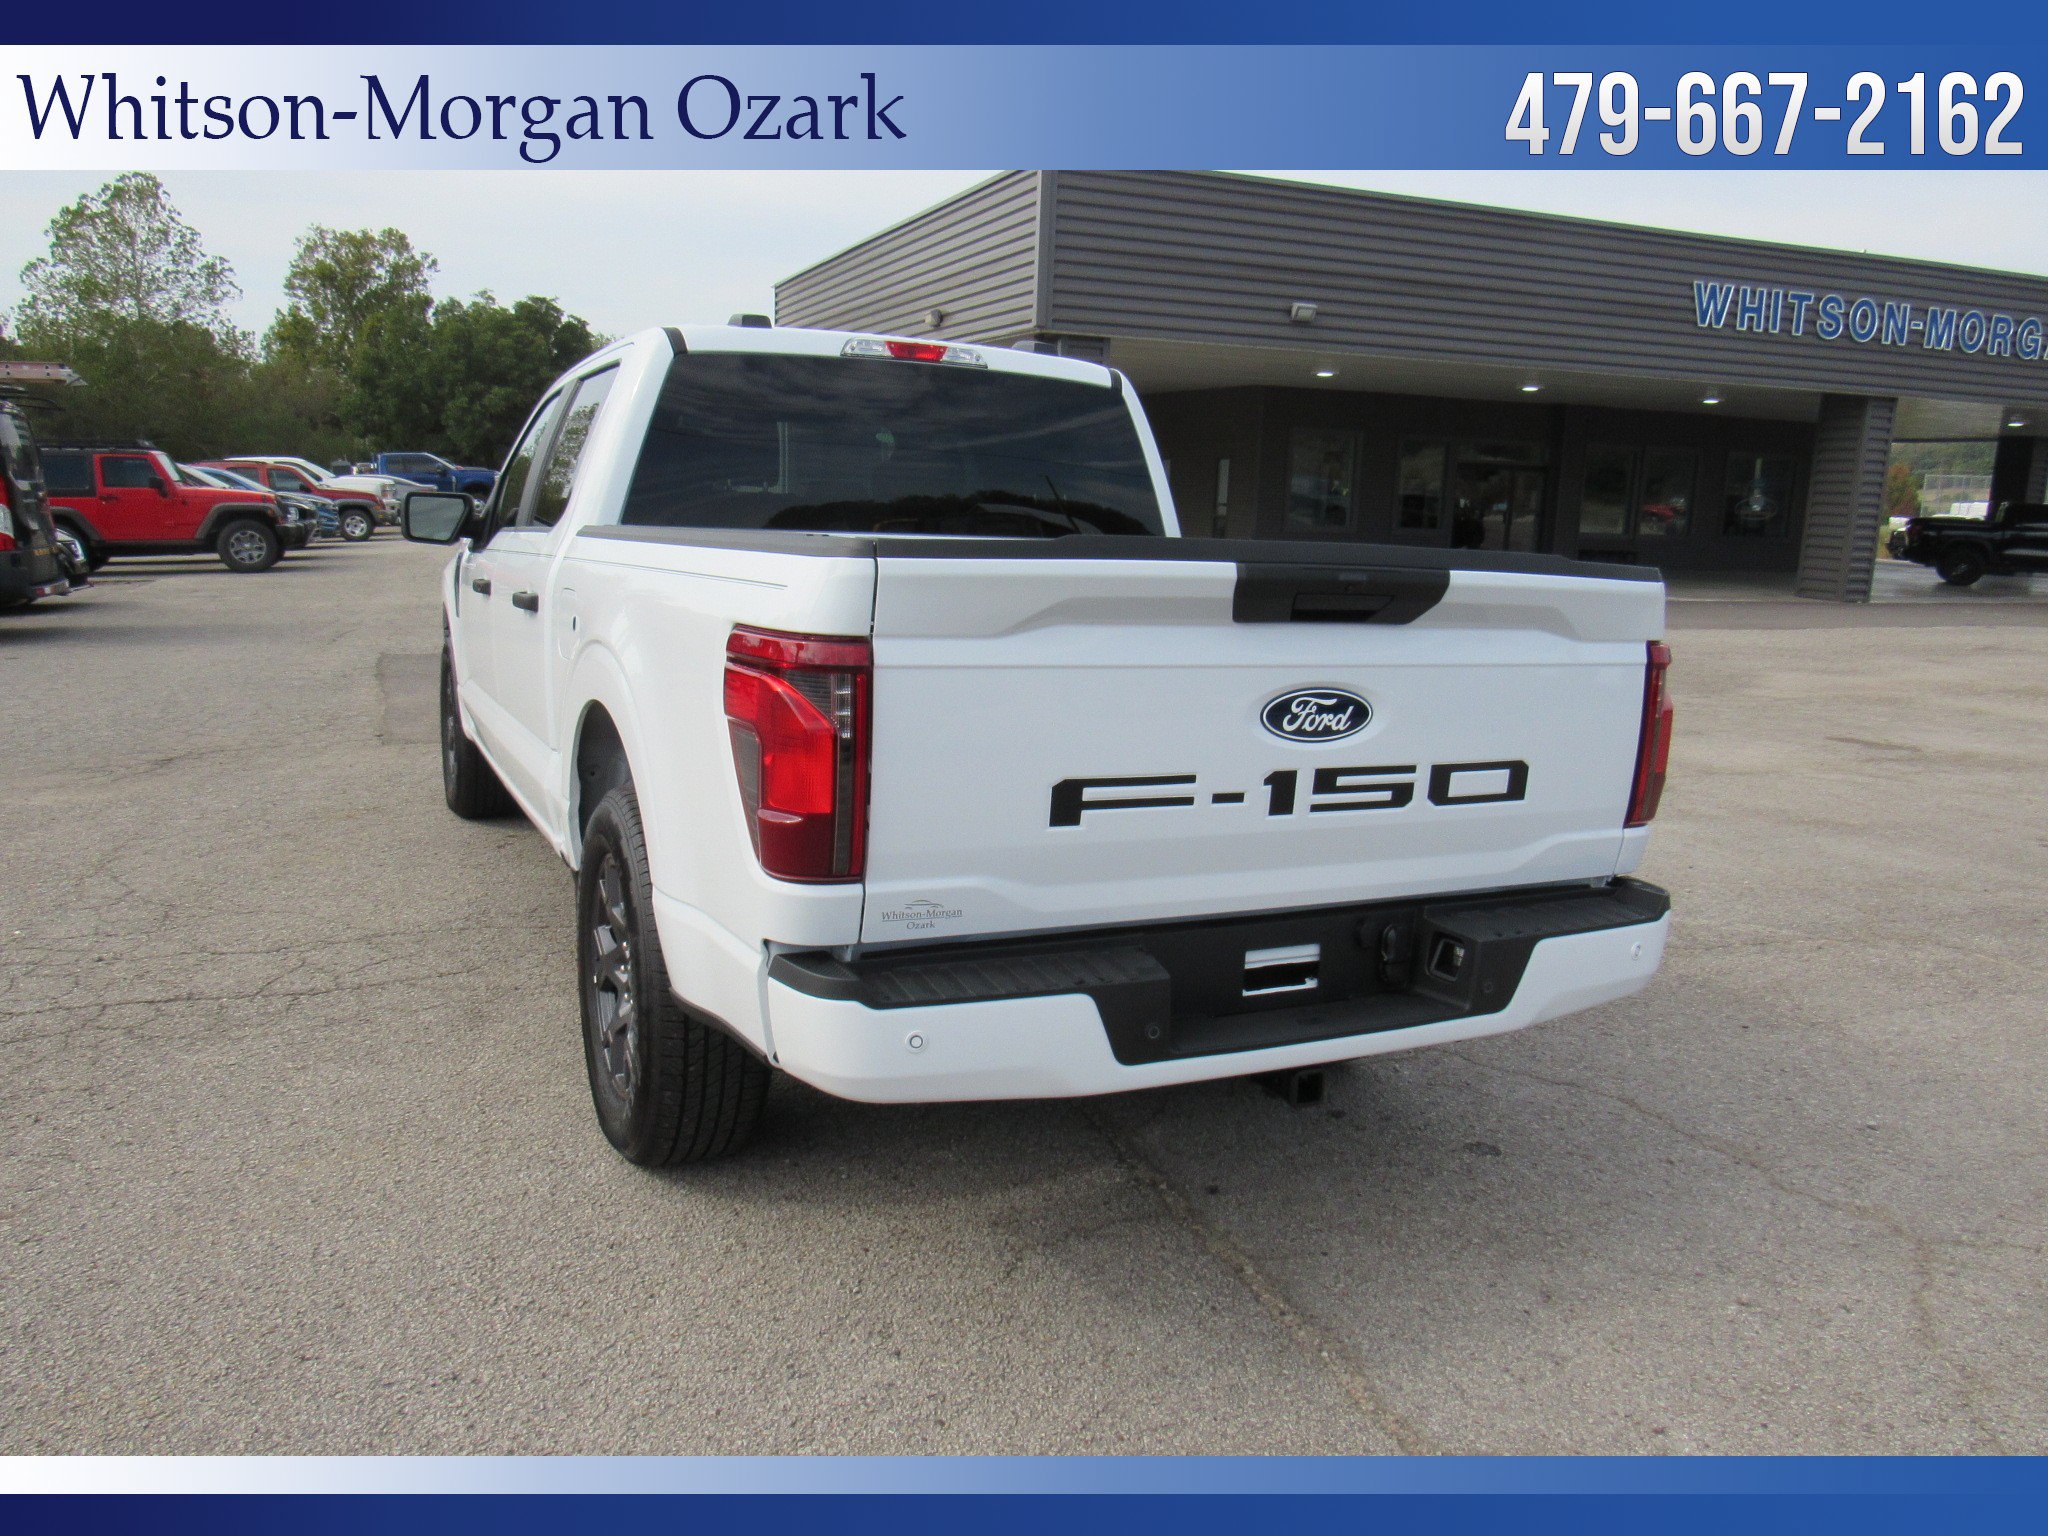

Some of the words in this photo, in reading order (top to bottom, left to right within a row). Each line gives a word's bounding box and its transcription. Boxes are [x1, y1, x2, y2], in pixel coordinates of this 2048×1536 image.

[1693, 280, 2048, 361] WHITSON-MORG
[1282, 696, 1352, 732] Ford
[1049, 760, 1530, 827] F-150
[881, 909, 963, 921] Whitson-Morgan
[906, 920, 936, 930] Ozark
